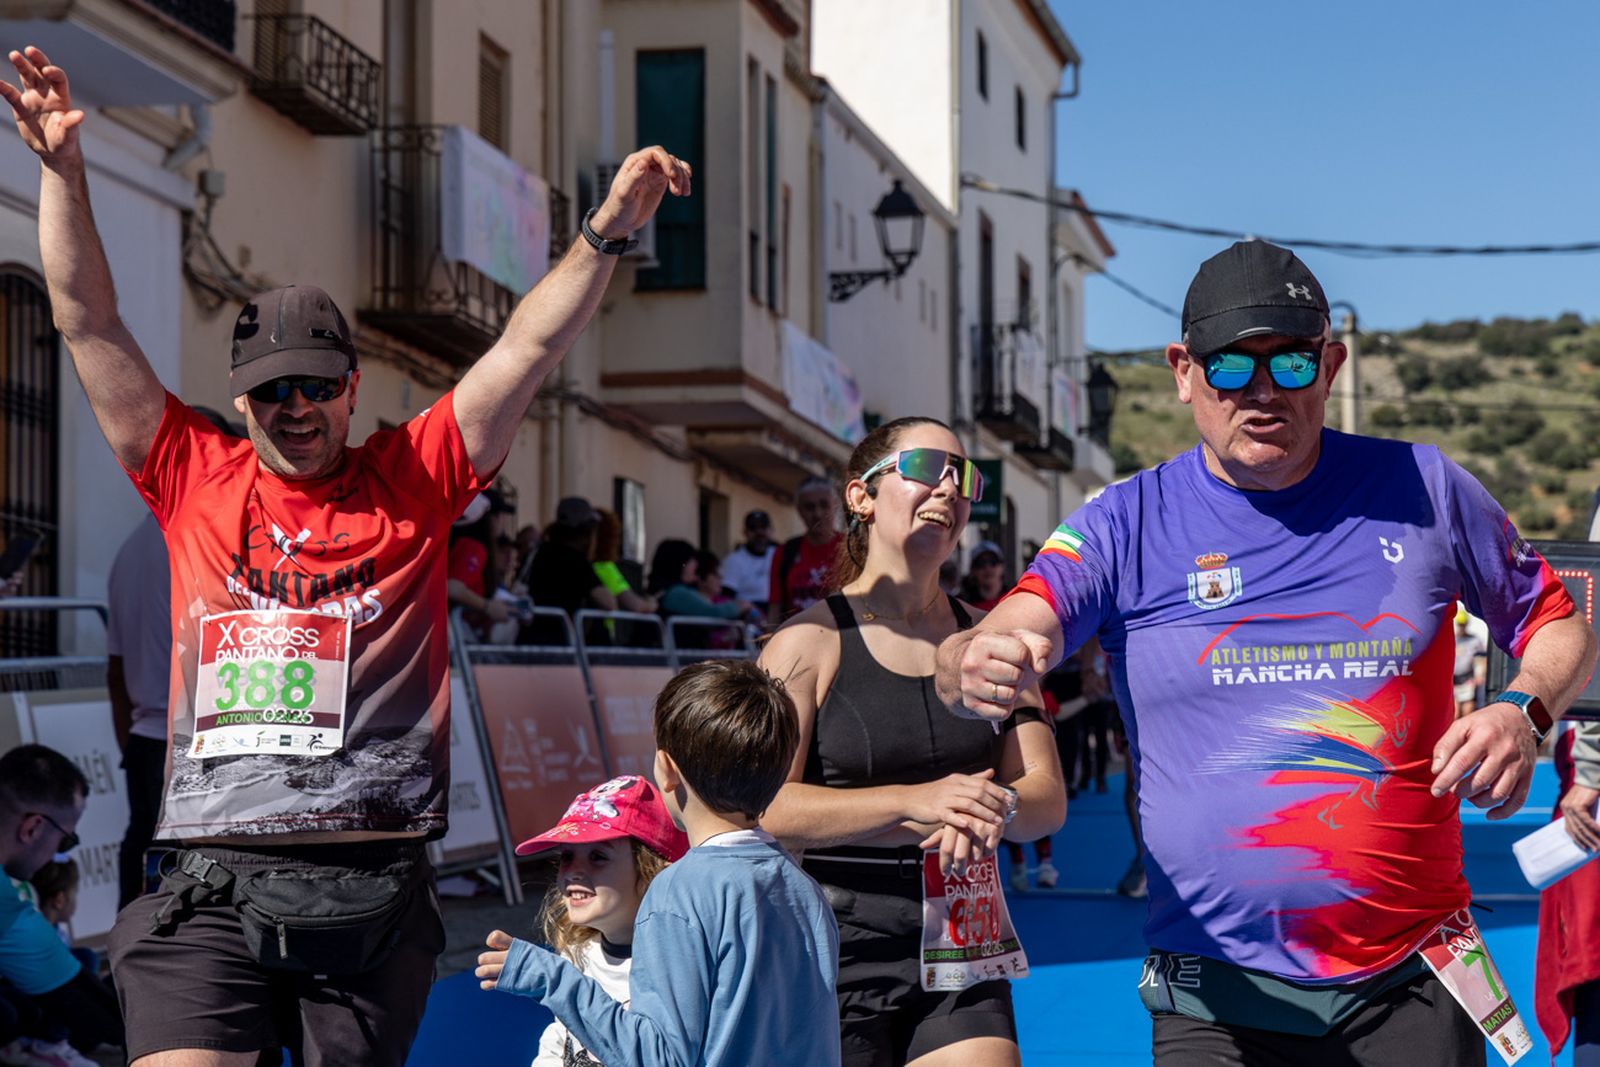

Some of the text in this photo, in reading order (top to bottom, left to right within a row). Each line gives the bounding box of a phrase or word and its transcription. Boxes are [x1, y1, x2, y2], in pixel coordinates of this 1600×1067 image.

[217, 619, 238, 649] X
[239, 626, 320, 648] CROSS
[215, 645, 299, 666] PANTANO
[1211, 636, 1413, 665] ATLETISMO Y MONTAÑA
[215, 660, 315, 711] 388
[1211, 659, 1414, 686] MANCHA REAL
[215, 712, 263, 726] ANTONIO
[1482, 1002, 1513, 1033] MATIAS
